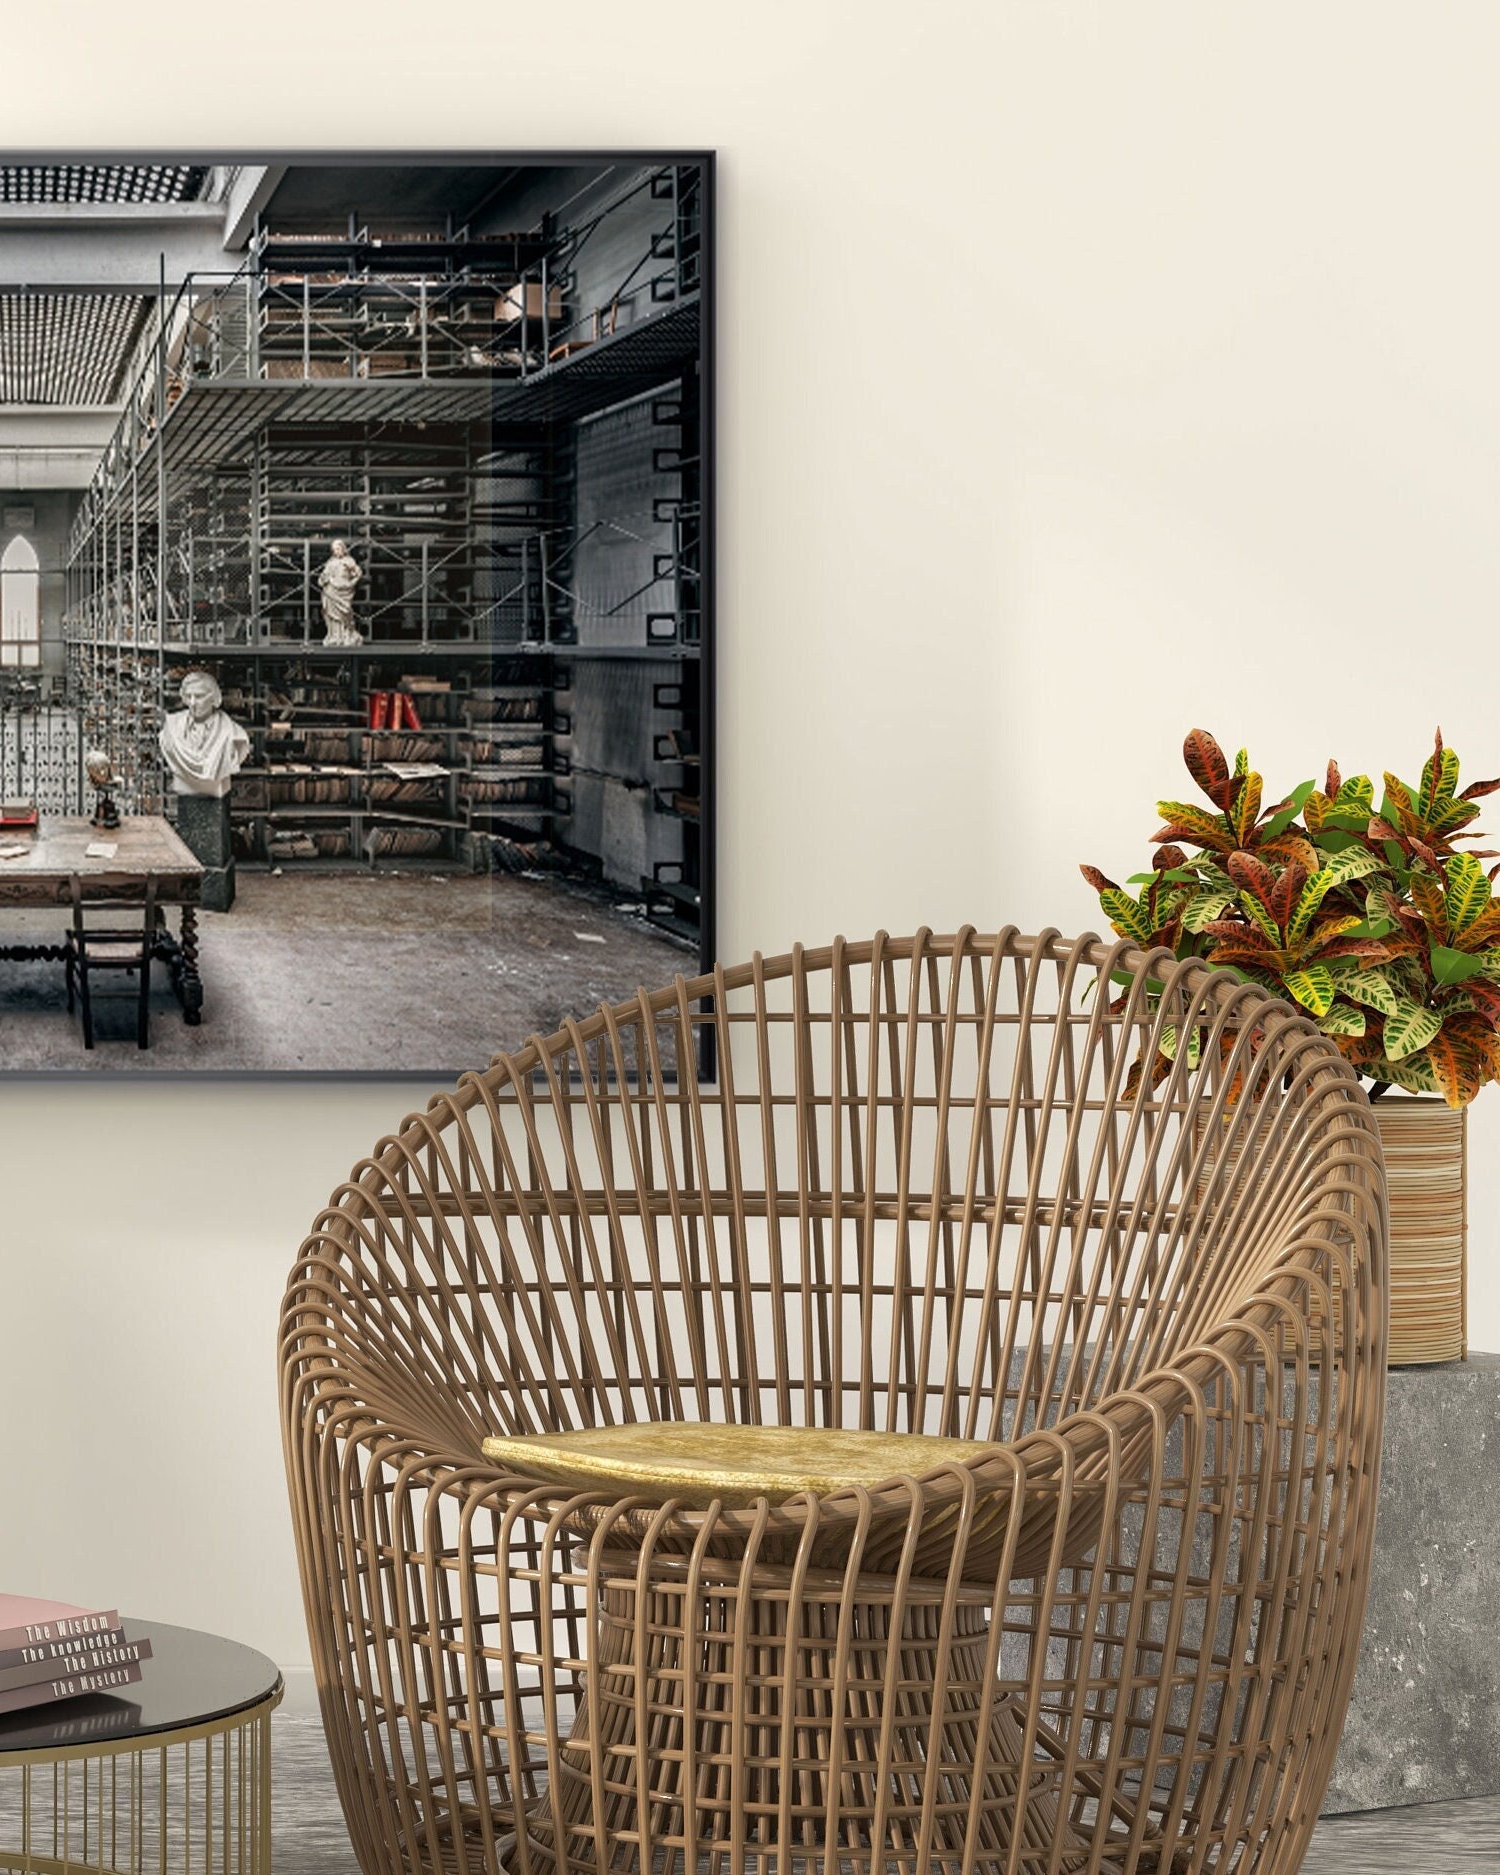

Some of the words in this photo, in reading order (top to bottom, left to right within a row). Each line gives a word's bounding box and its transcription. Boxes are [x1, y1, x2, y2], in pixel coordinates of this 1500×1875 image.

[26, 1626, 50, 1642] The
[56, 1615, 109, 1637] Wisdom
[21, 1647, 45, 1663] The
[50, 1632, 117, 1658] knowledge
[63, 1656, 87, 1673] The
[91, 1645, 140, 1667] History
[52, 1680, 74, 1697] The
[79, 1668, 130, 1691] Mystery
